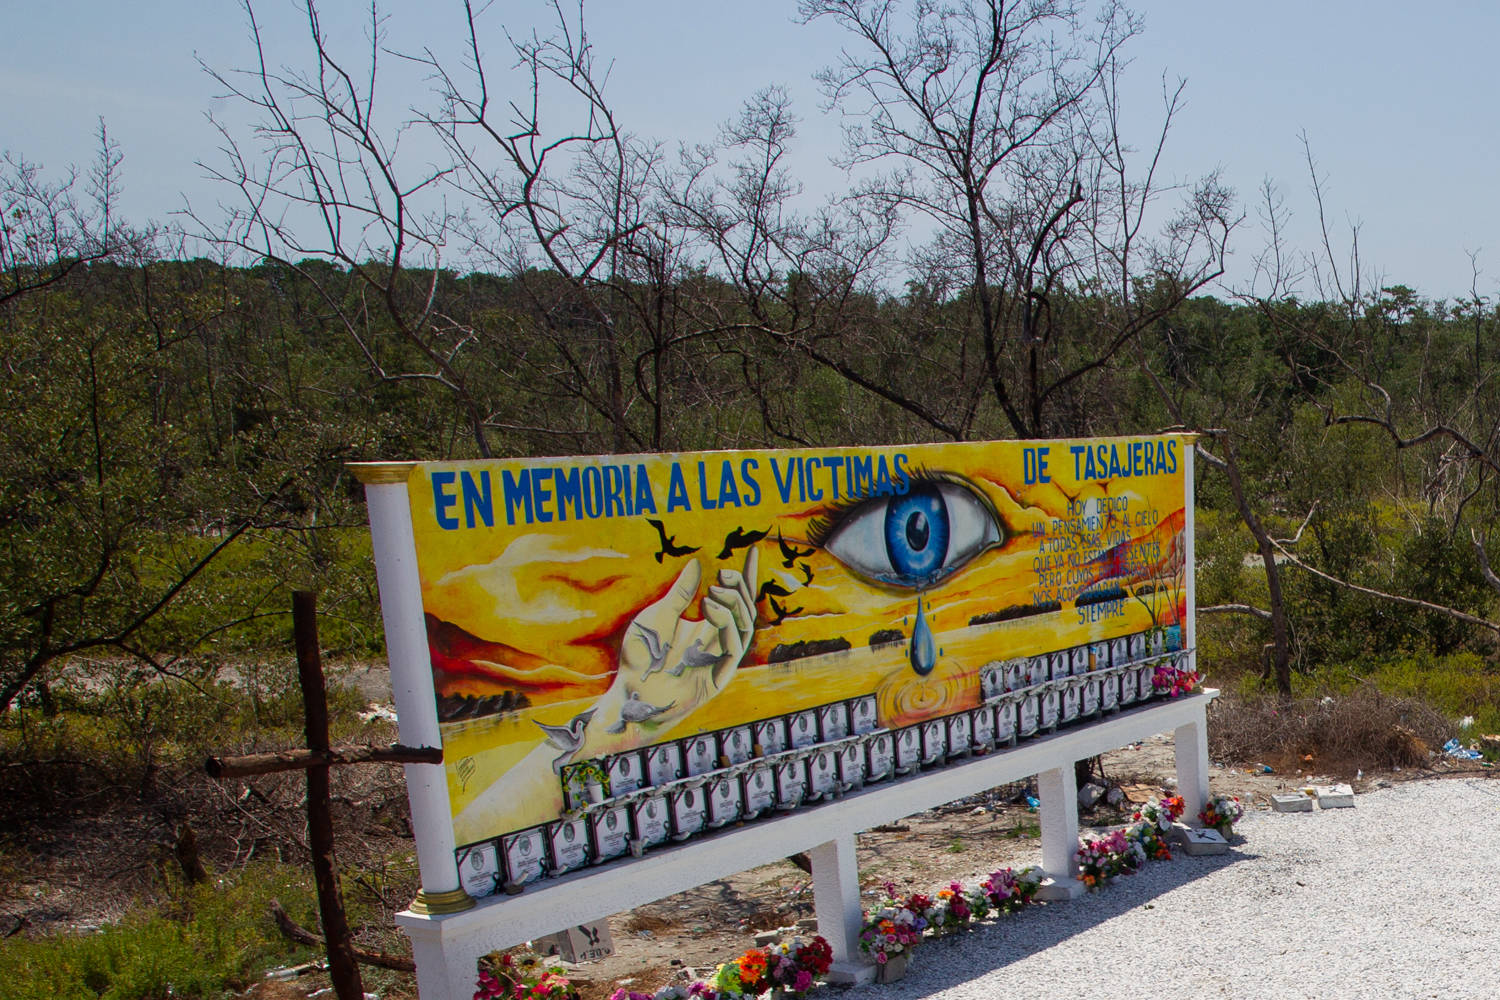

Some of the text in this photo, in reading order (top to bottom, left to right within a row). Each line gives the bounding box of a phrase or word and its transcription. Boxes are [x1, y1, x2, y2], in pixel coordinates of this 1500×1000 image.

[431, 440, 1177, 530] EN MEMORIA A LAS VICTIMAS DE TASAJERAS
[1066, 495, 1128, 516] HOY DEDICO
[1032, 520, 1046, 538] UN
[1122, 512, 1132, 528] AL
[1135, 509, 1159, 527] CIELO
[1038, 538, 1045, 554] A
[1048, 535, 1078, 553] TODAS
[1033, 556, 1052, 573] QUE
[1053, 554, 1064, 570] YA
[1067, 552, 1081, 568] NO
[1038, 571, 1062, 588] PERO
[1066, 567, 1094, 585] CUYOS
[1032, 590, 1053, 609] NOS
[1077, 598, 1126, 625] SIEMPRE
